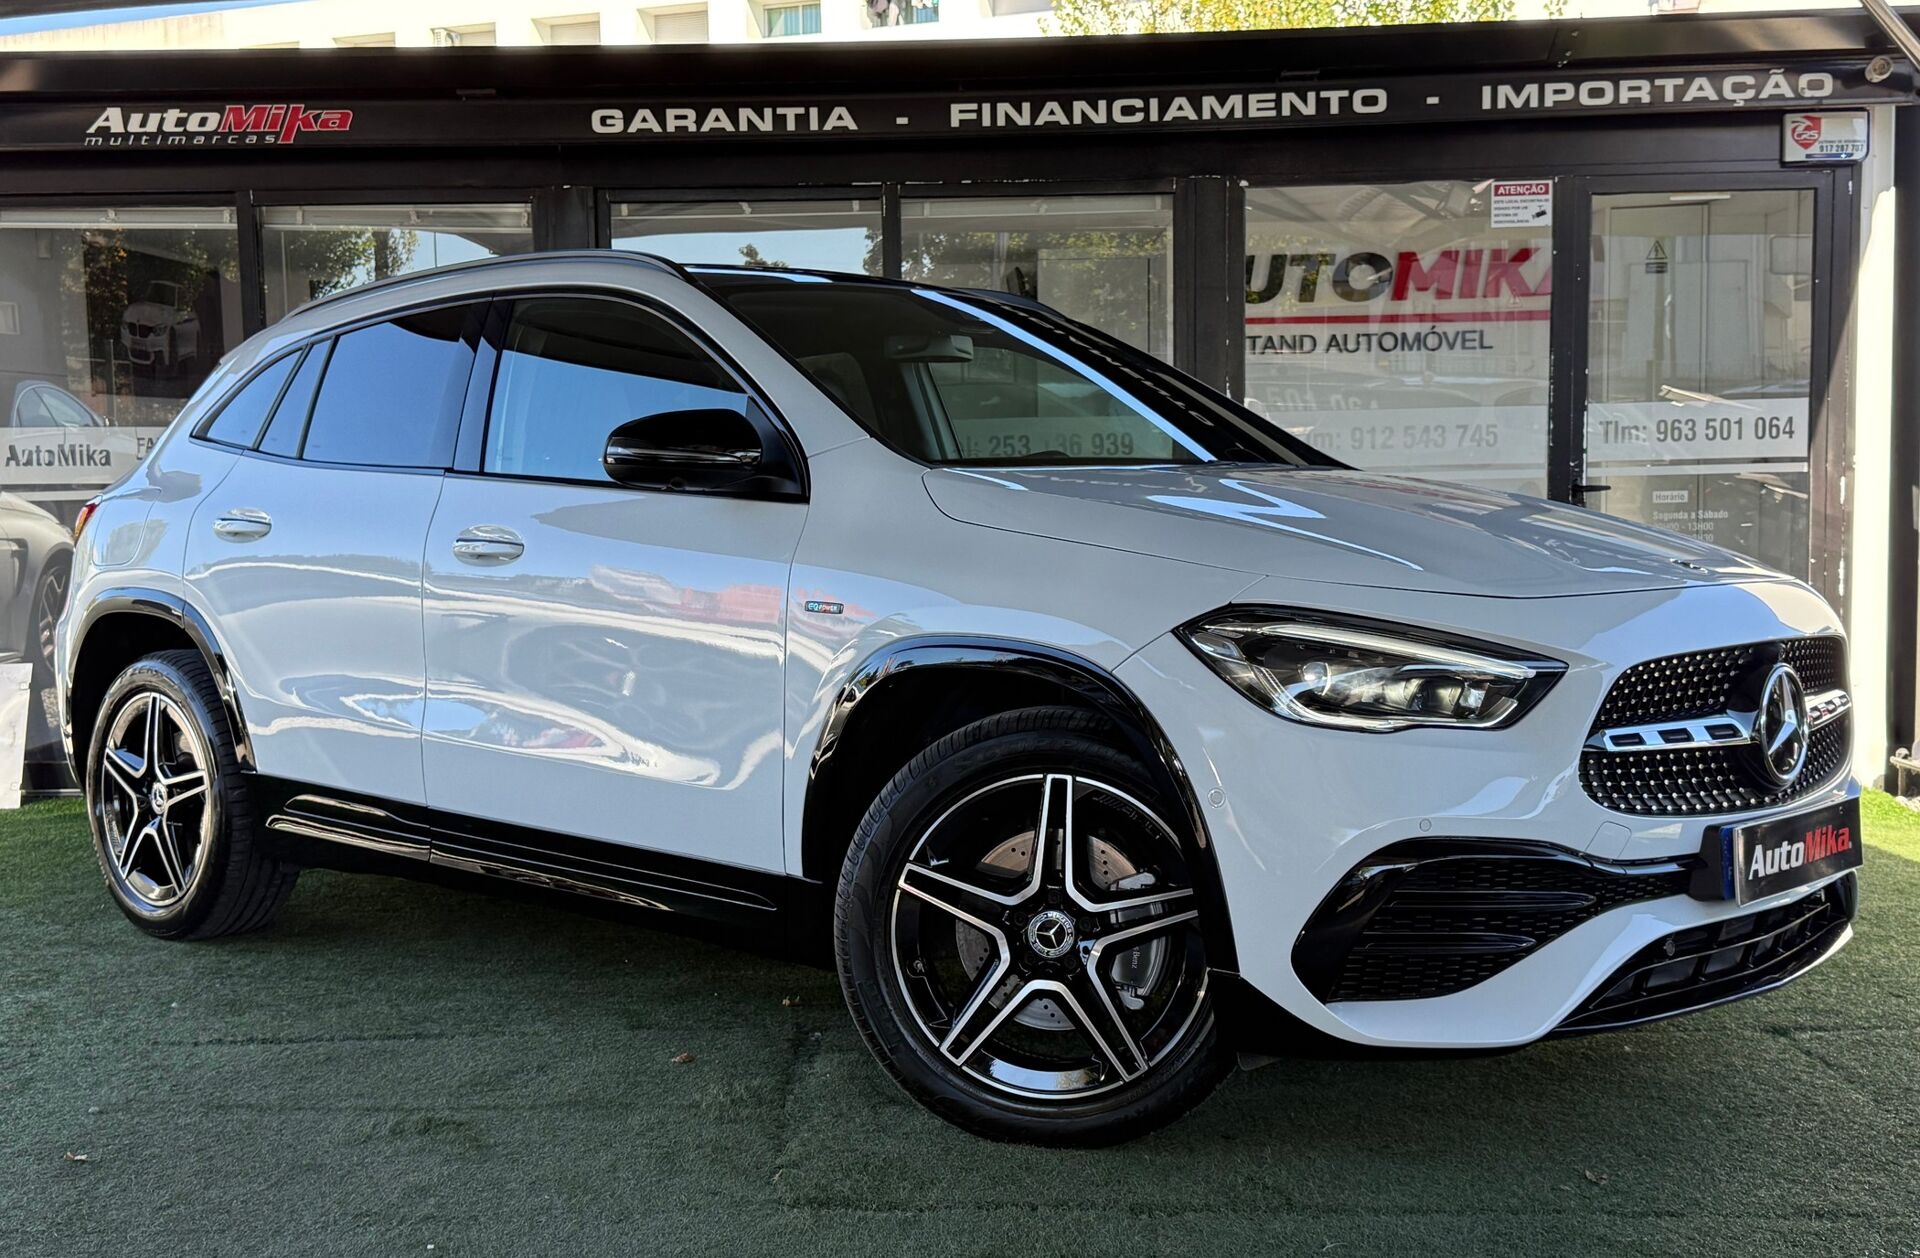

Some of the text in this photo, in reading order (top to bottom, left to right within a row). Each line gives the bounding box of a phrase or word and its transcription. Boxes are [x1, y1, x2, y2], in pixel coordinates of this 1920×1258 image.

[591, 106, 858, 134] GARANTIA
[950, 88, 1388, 128] FINANCIAMENTO
[1482, 68, 1834, 110] IMPORTAÇÃO
[86, 104, 354, 144] AutoMika
[84, 133, 280, 147] multimarcas
[1498, 184, 1546, 195] ATENÇÃO
[1246, 248, 1551, 305] UTOMIK
[1246, 325, 1494, 355] TAND AUTOMÓVEL
[1351, 426, 1394, 450] 912
[1403, 425, 1447, 448] 543
[1455, 424, 1498, 448] 745
[1656, 418, 1697, 442] 963
[1705, 417, 1744, 441] 501
[1755, 416, 1795, 440] 064
[5, 444, 112, 467] AutoMika
[136, 437, 160, 454] FA
[988, 434, 1031, 457] 253
[1092, 432, 1134, 456] 939
